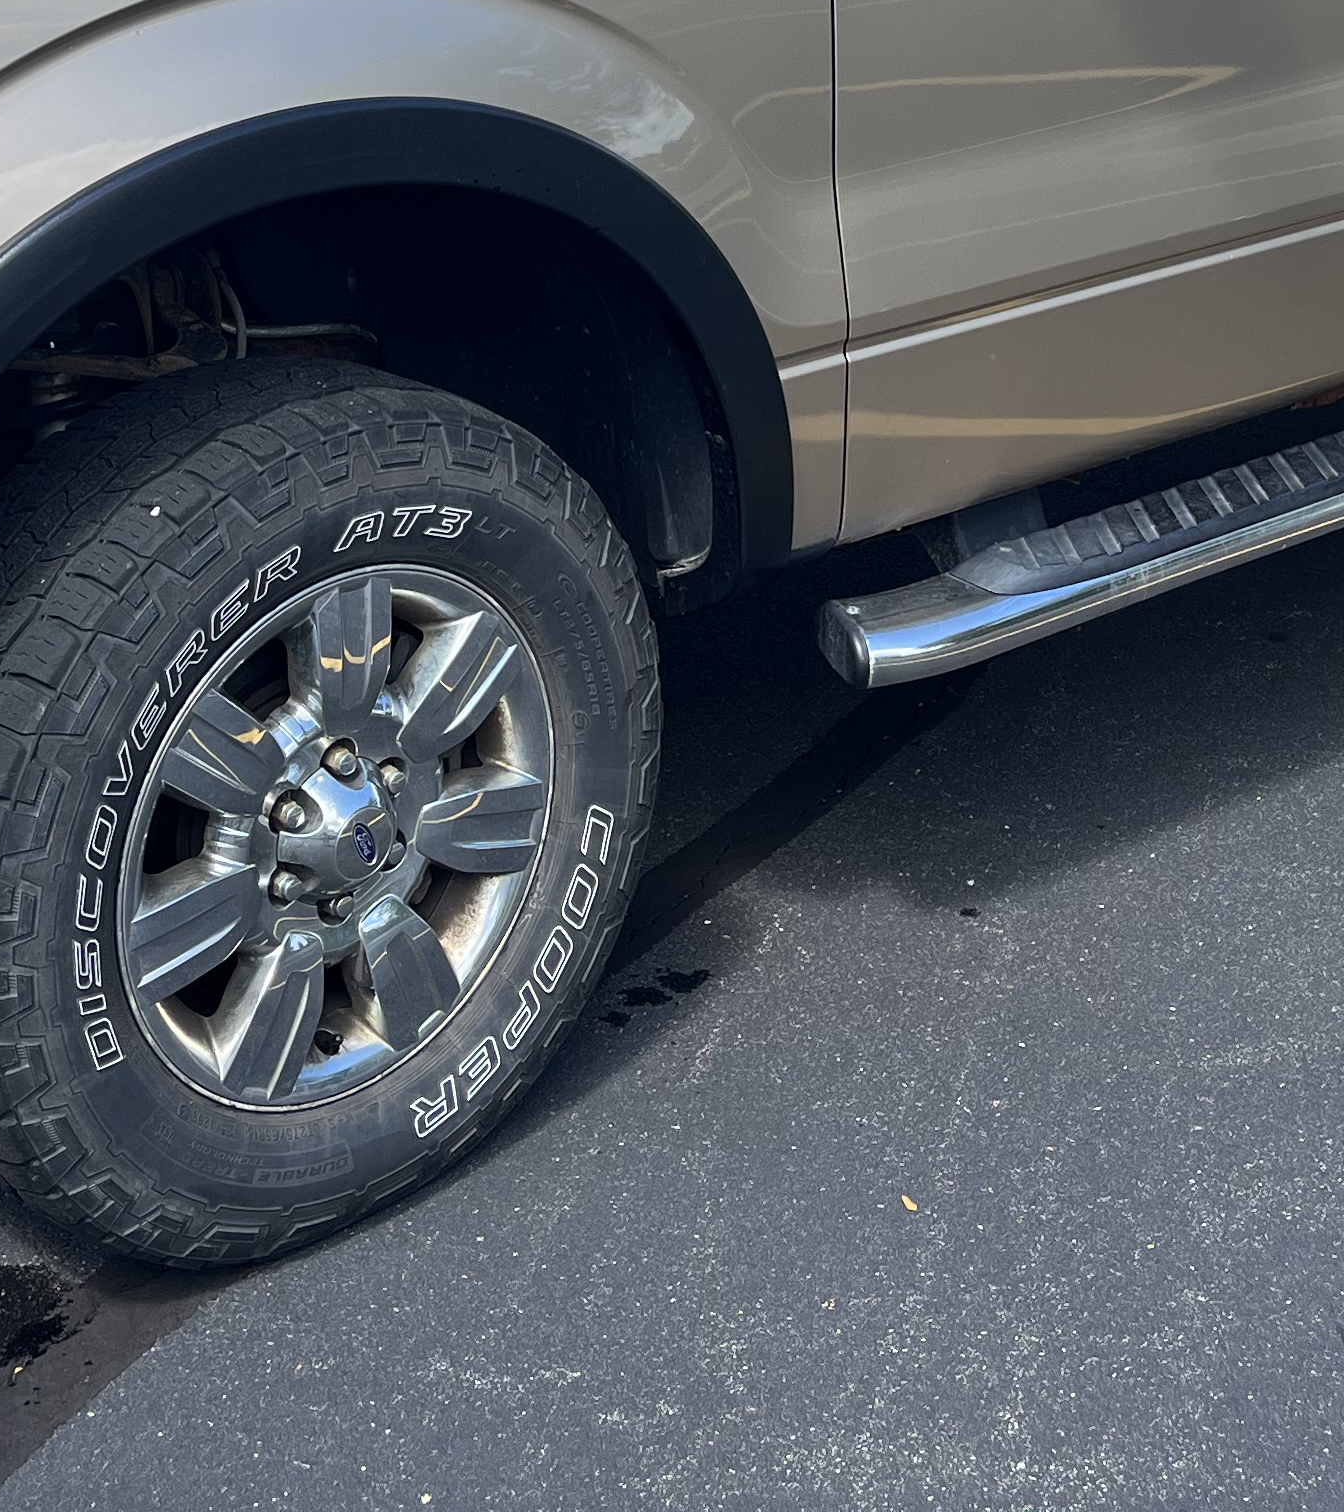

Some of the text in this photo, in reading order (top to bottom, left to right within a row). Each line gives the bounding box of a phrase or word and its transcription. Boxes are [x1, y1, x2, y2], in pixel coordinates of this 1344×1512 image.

[72, 544, 303, 1073] DISCOVERER
[334, 503, 476, 555] AT3
[410, 803, 616, 1141] COOPER
